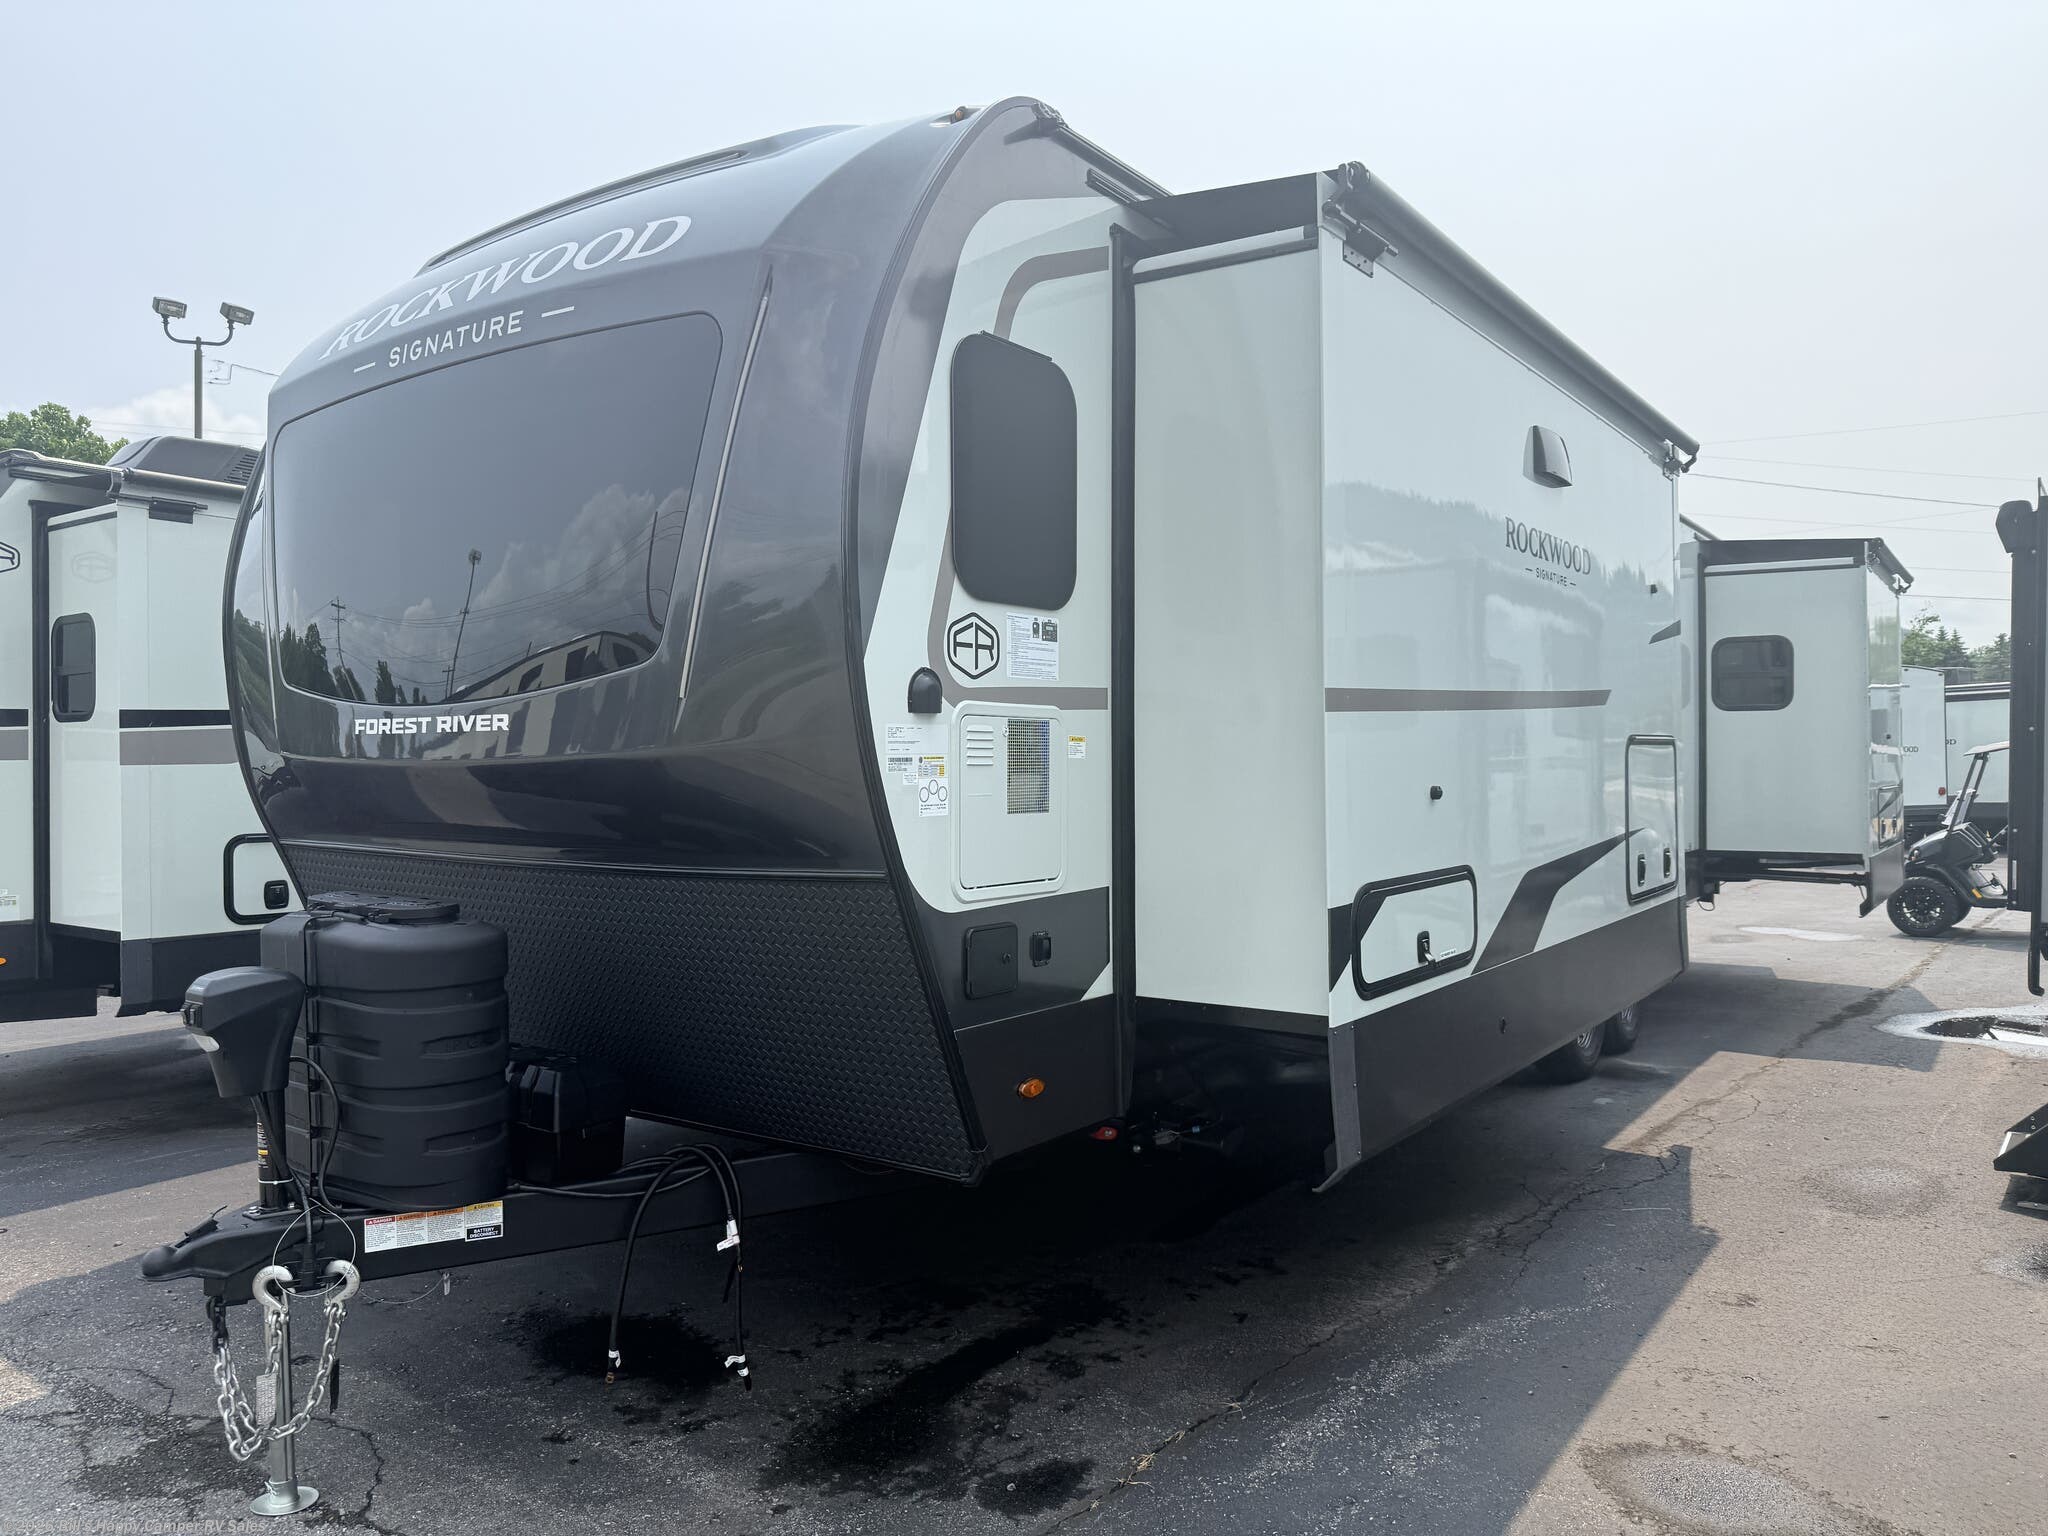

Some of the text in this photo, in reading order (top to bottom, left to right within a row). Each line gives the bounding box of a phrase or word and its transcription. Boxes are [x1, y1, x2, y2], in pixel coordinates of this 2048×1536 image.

[319, 215, 692, 360] ROCKWOOD
[388, 311, 524, 368] SIGNATURE
[1505, 516, 1591, 575] ROCKWOOD
[355, 714, 510, 735] FOREST RIVER
